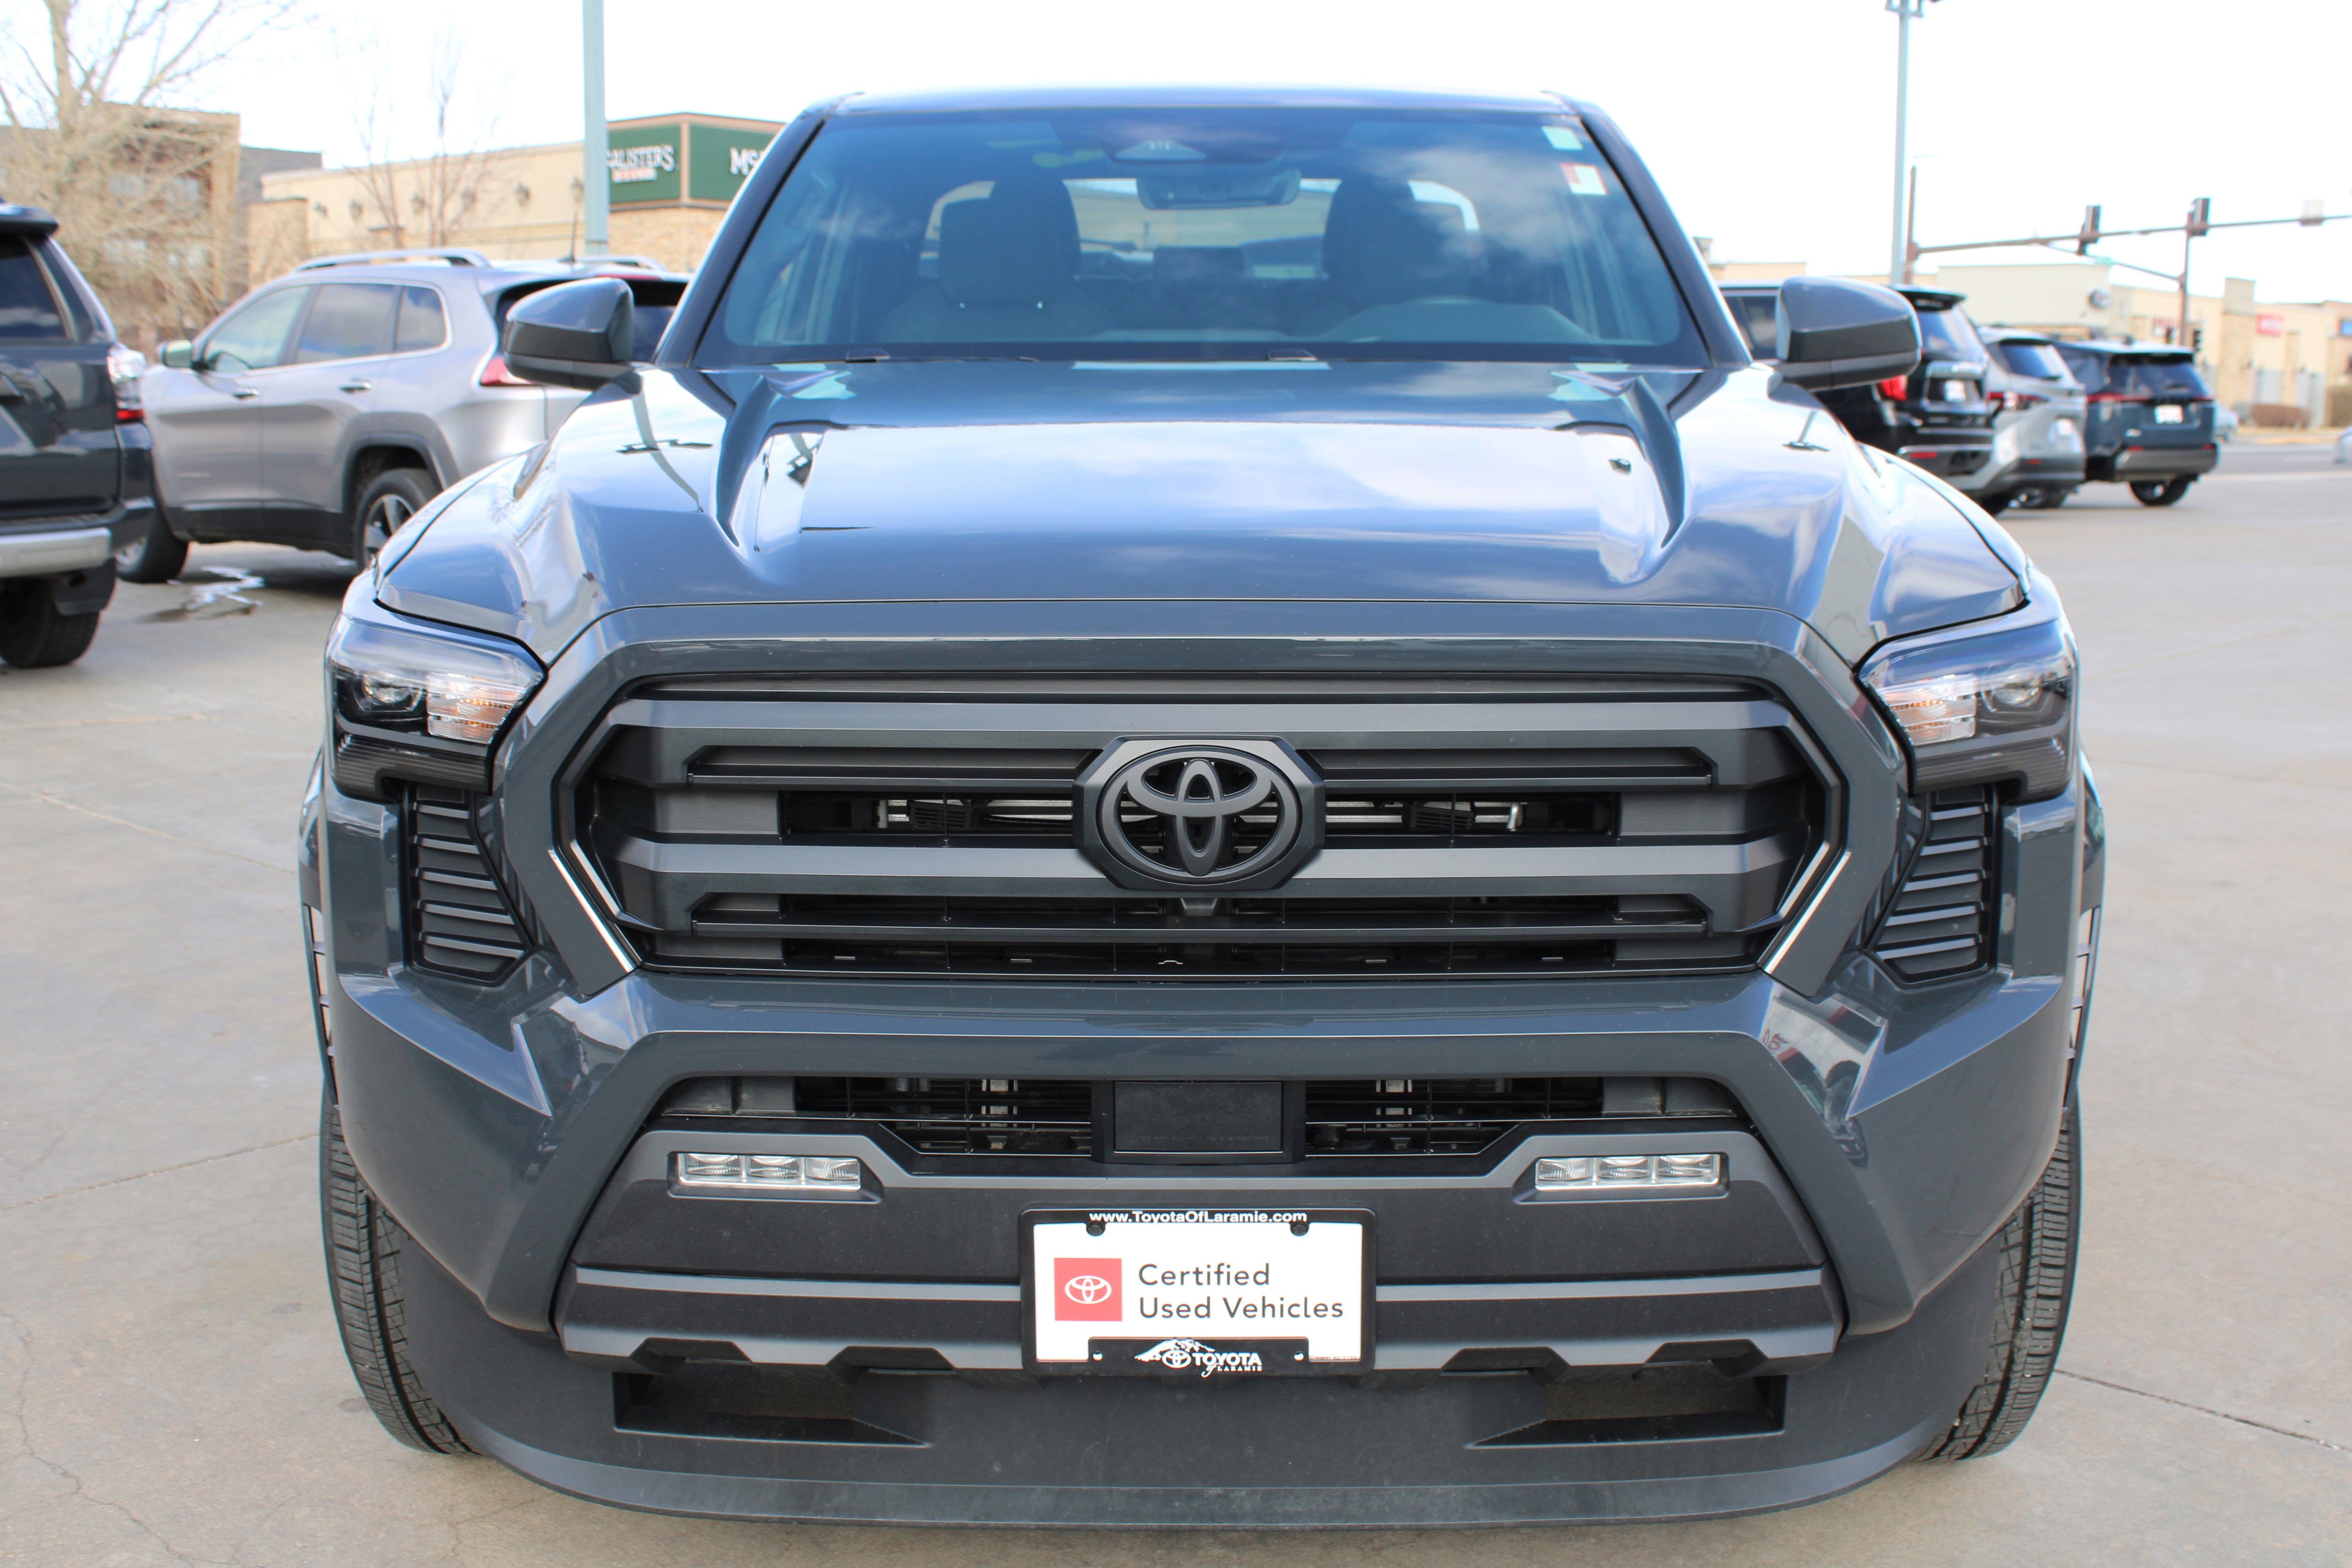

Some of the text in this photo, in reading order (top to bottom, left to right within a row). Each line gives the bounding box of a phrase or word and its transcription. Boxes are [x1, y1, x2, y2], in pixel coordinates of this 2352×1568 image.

[1089, 1211, 1307, 1225] www.ToyotaOfLaramie.com
[1138, 1263, 1270, 1286] Certified
[1140, 1296, 1343, 1319] Used Vehicles
[1192, 1352, 1263, 1366] TOYOTA
[1201, 1363, 1219, 1378] of
